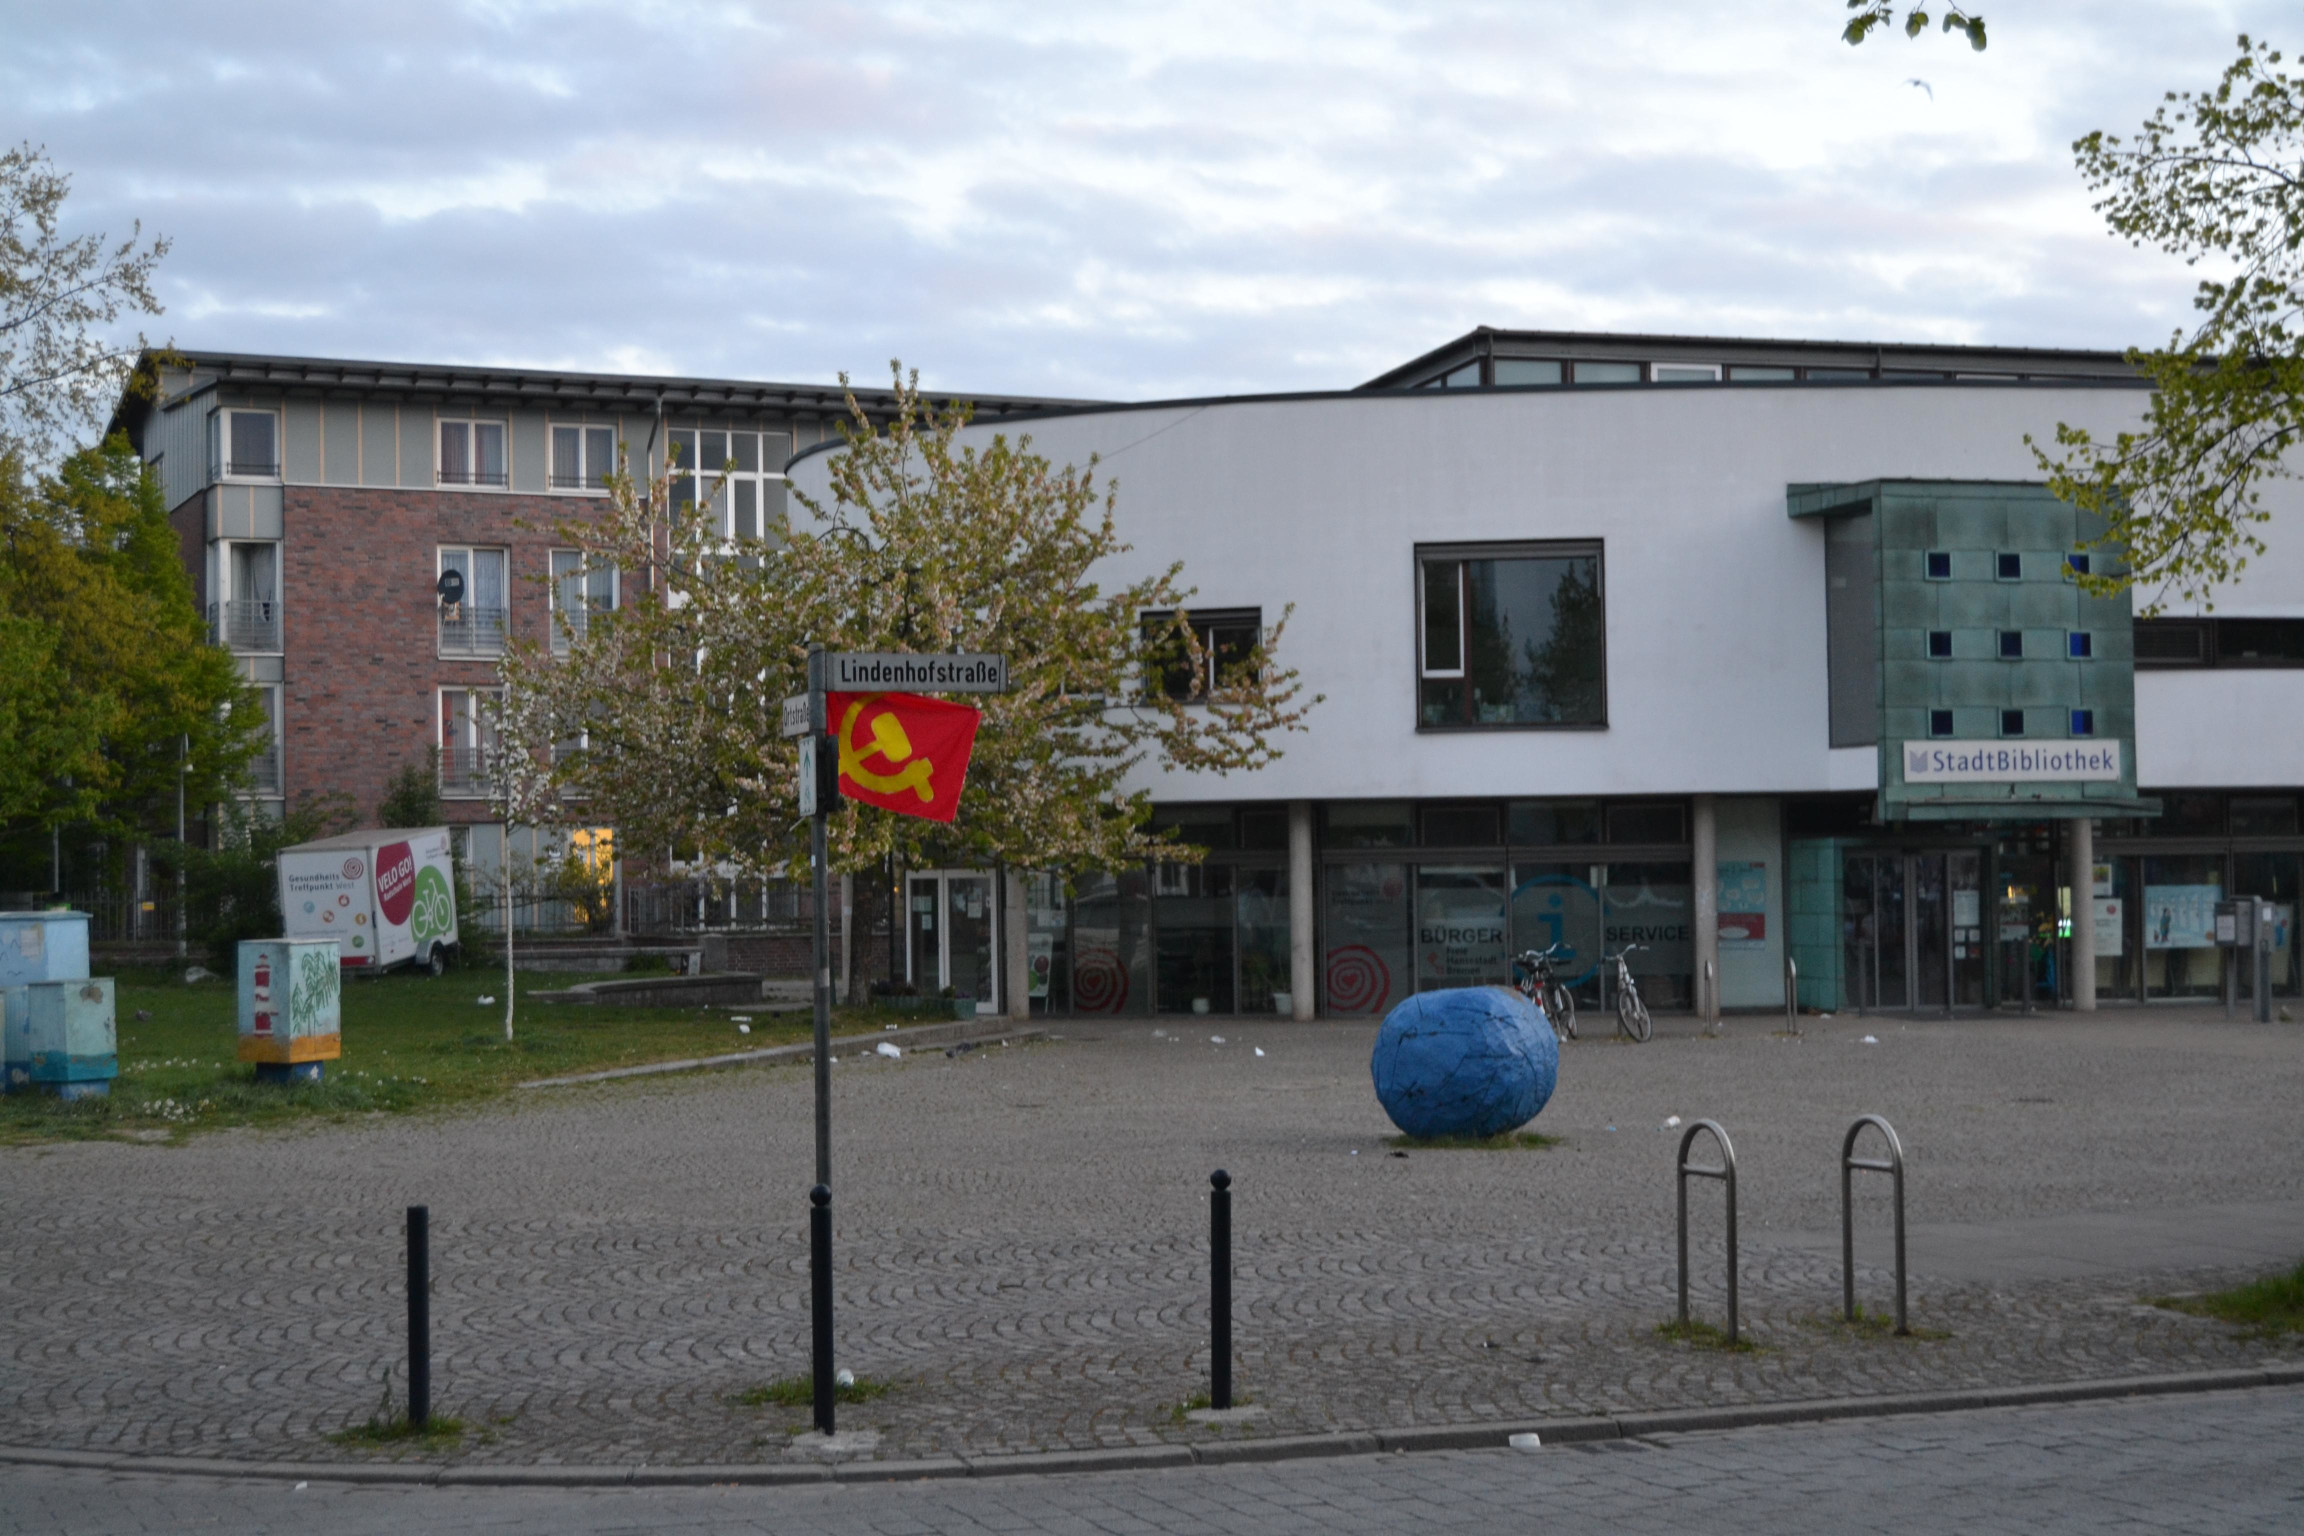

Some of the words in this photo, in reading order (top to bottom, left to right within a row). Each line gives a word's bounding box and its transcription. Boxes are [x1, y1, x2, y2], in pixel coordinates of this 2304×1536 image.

[840, 659, 998, 683] Lindenhofstraße
[783, 702, 810, 728] Ortstraße
[1933, 748, 2114, 772] StadtBibliothek
[288, 873, 340, 883] Gesundheits
[378, 866, 398, 893] VELO
[398, 855, 413, 878] GO!
[290, 882, 334, 892] Treffpunkt
[1420, 925, 1503, 944] BÜRGER
[1606, 925, 1690, 943] SERVICE
